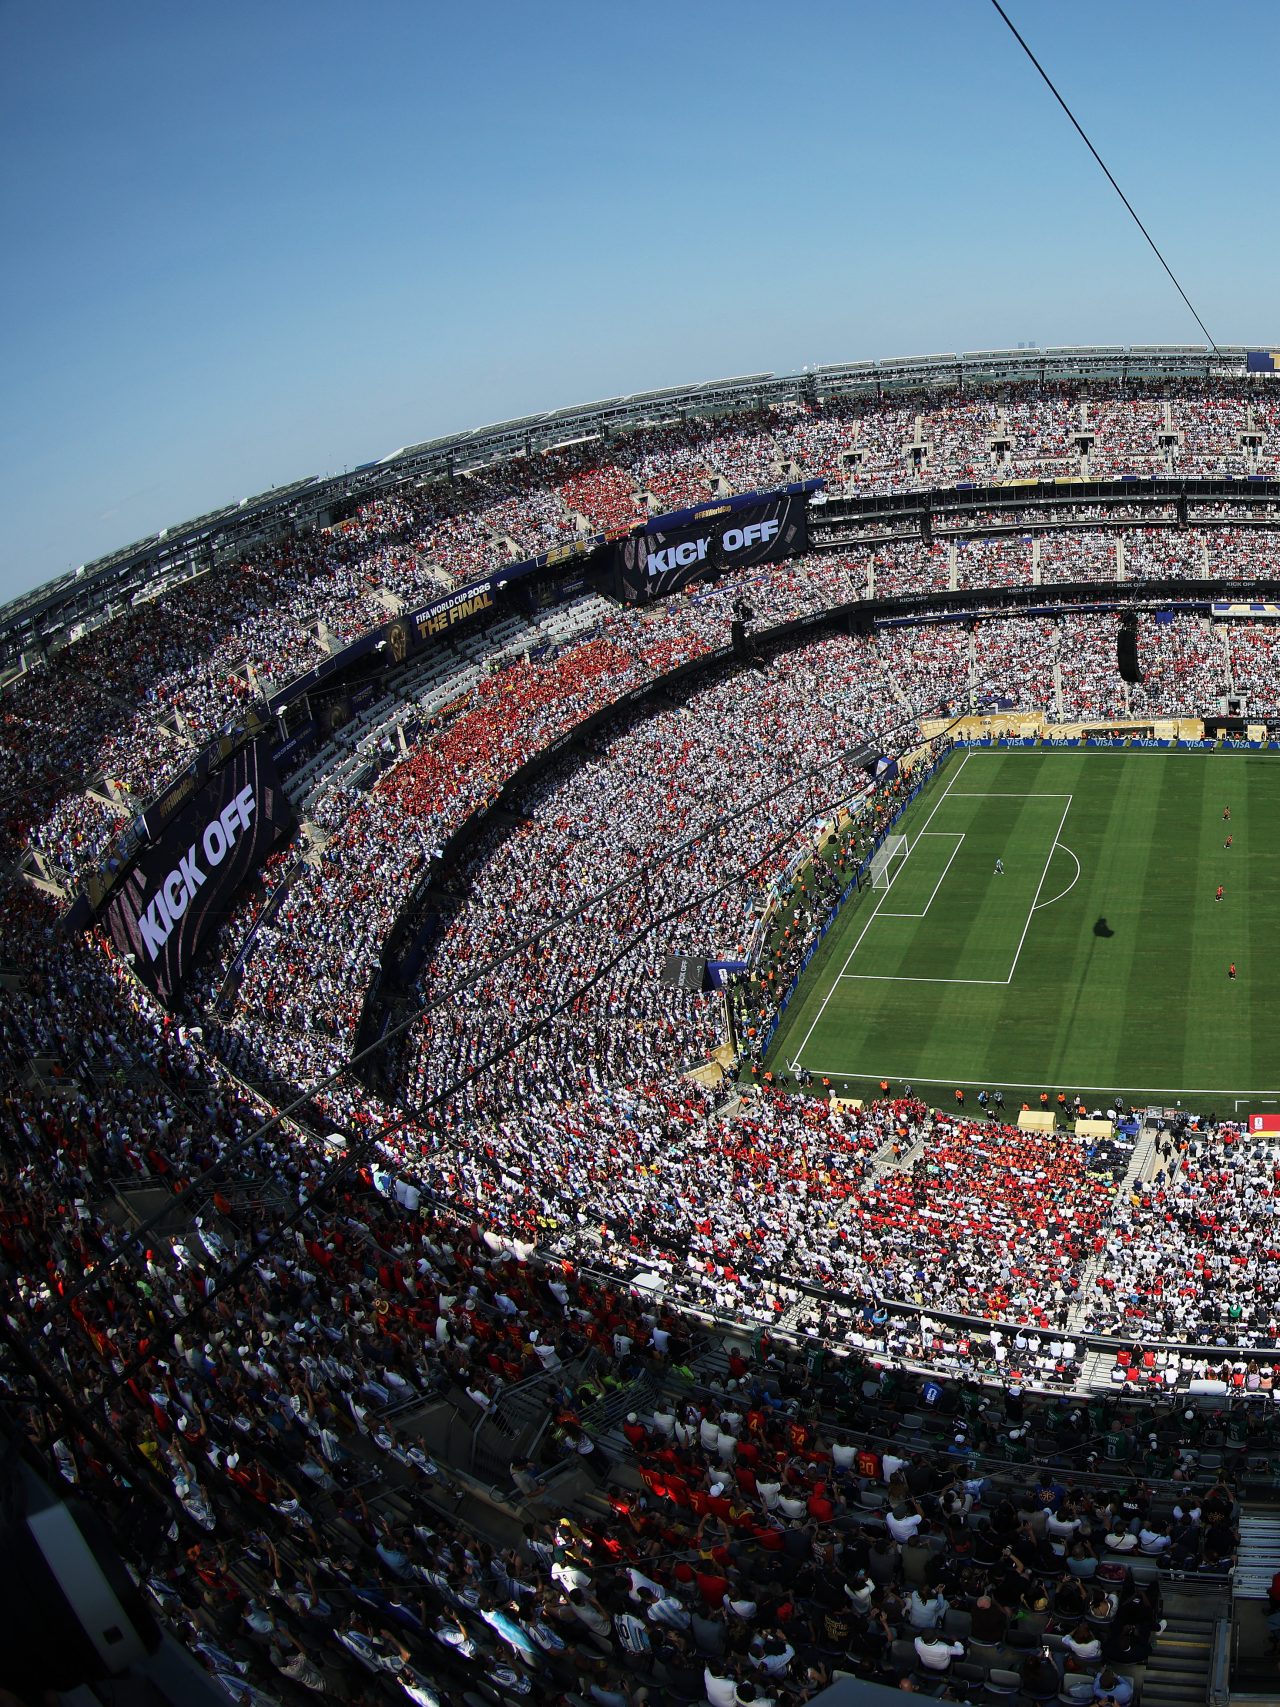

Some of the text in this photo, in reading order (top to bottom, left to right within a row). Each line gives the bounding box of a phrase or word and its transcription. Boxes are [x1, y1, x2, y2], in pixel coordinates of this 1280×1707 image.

[722, 519, 779, 552] OFF
[416, 582, 491, 624] FIFA WORLD CUP 2026
[418, 592, 494, 640] THE FINAL
[802, 616, 815, 624] KICK
[137, 843, 208, 962] KICK
[202, 783, 256, 867] OFF
[749, 1418, 757, 1431] 4
[860, 1462, 874, 1478] 20
